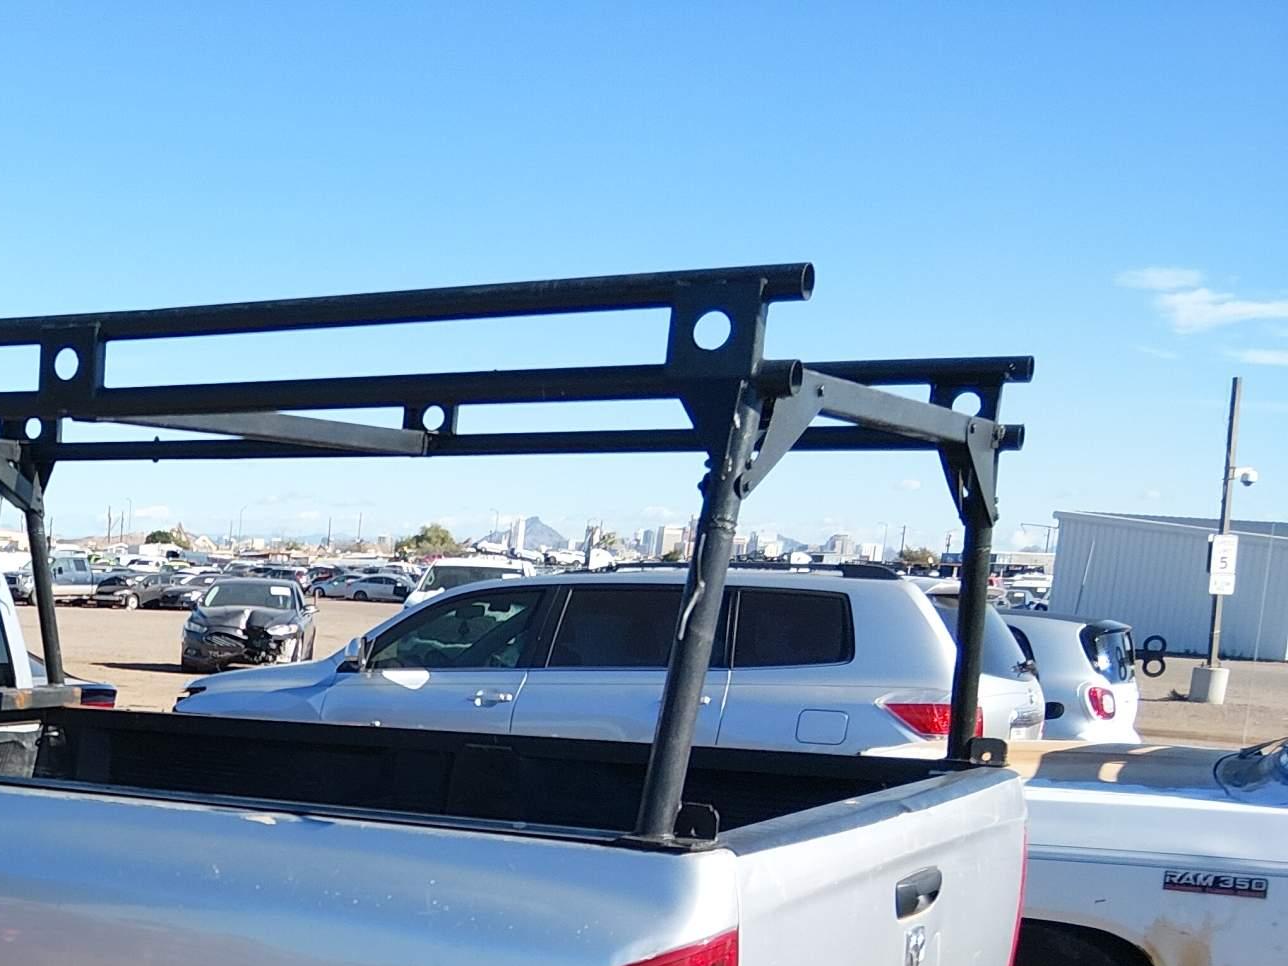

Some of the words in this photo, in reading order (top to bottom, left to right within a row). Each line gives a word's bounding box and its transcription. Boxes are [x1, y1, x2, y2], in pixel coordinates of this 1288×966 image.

[1219, 556, 1228, 569] 5
[1165, 871, 1213, 887] RAM
[1219, 876, 1267, 891] 350
